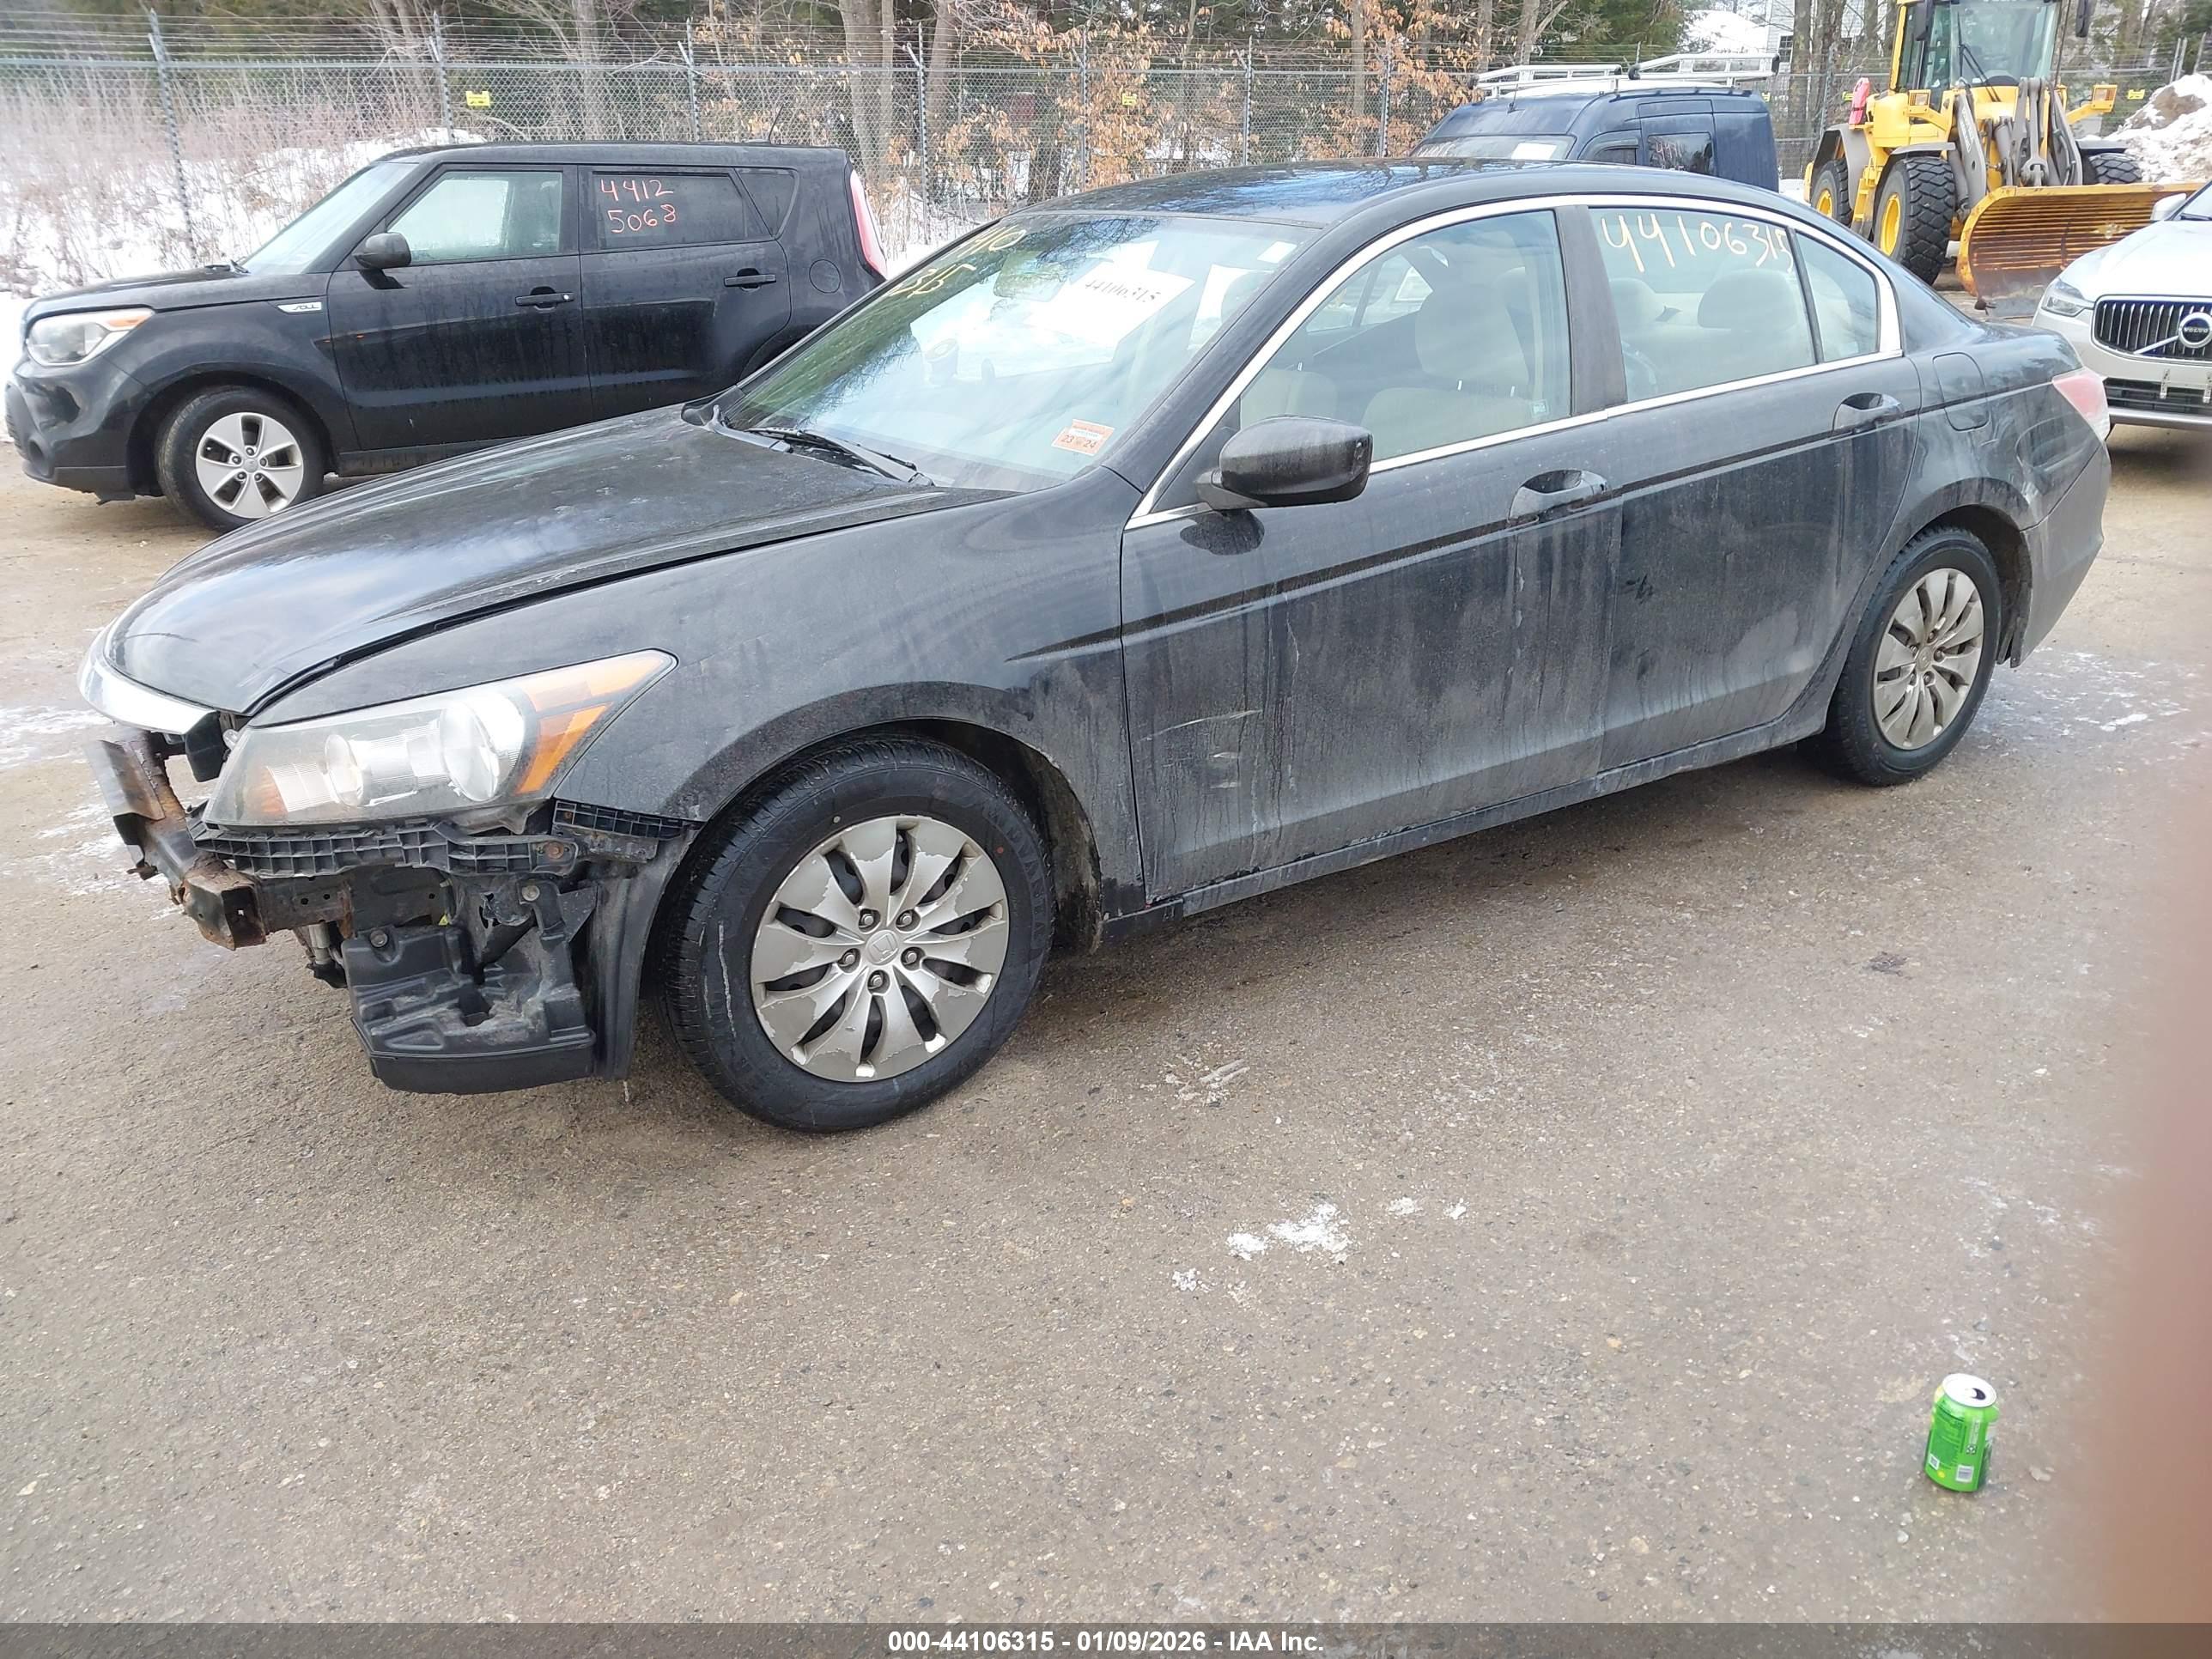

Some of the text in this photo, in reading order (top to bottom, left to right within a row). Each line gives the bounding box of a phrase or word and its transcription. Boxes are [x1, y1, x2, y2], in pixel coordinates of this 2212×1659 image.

[600, 178, 674, 203] 4412
[607, 204, 676, 233] 5068
[1601, 213, 1794, 273] 44106315
[1060, 434, 1097, 449] 23 24
